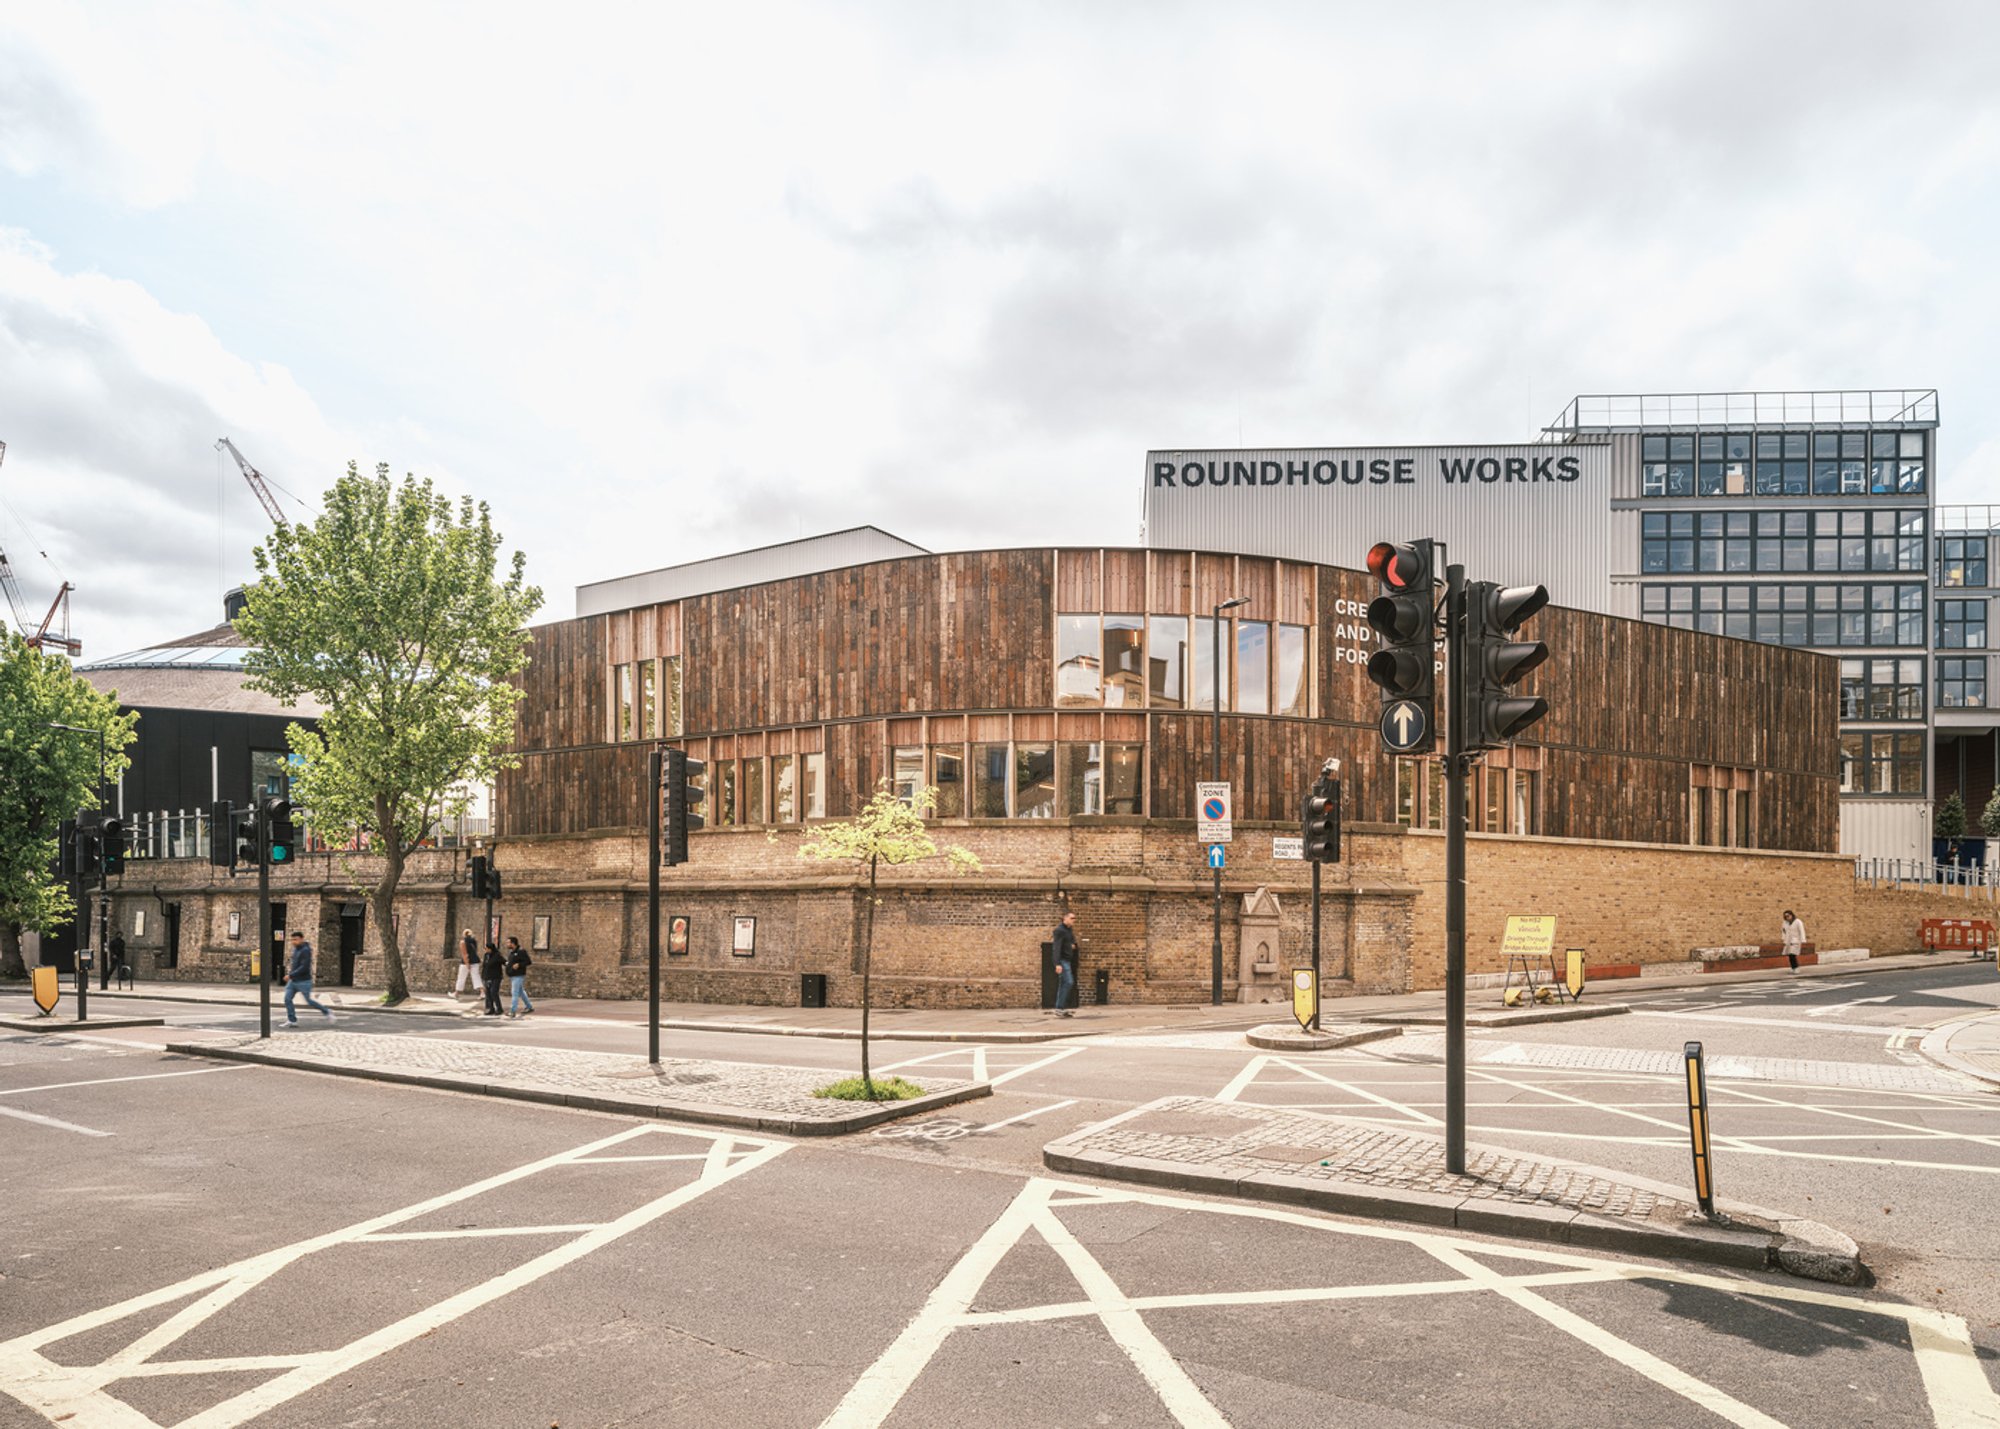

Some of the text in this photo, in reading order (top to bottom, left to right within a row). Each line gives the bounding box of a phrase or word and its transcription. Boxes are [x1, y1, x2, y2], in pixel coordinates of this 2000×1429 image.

[1154, 457, 1580, 488] ROUNDHOUSE WORKS
[1335, 599, 1368, 618] CRE
[1335, 623, 1370, 642] AND
[1335, 646, 1369, 666] FOR
